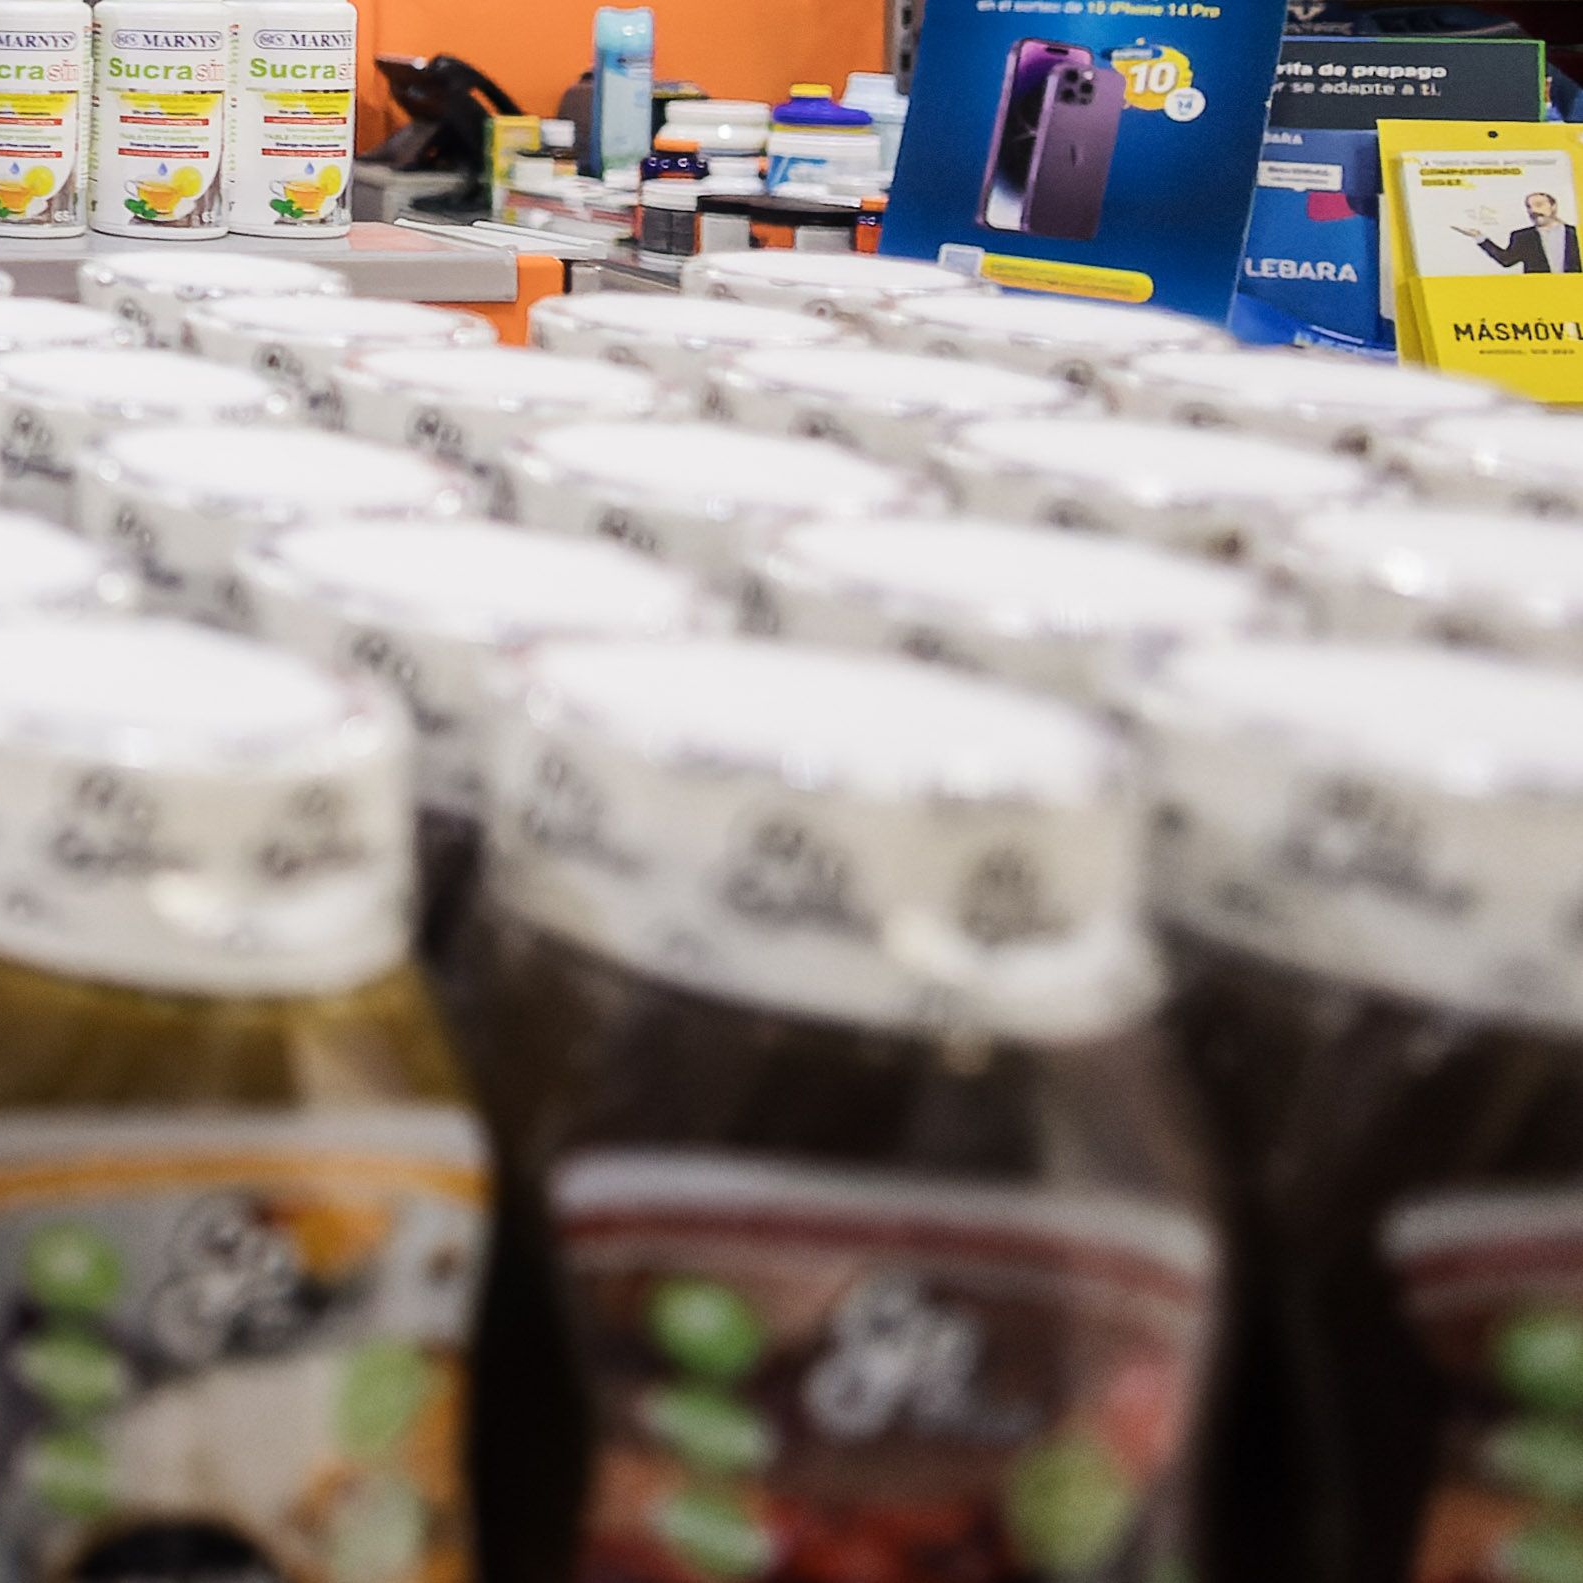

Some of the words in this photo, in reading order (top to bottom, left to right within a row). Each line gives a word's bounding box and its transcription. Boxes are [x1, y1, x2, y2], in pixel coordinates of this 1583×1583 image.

[143, 32, 217, 49] MARNYS
[1129, 61, 1178, 94] 10
[1318, 63, 1347, 77] de
[1351, 65, 1447, 81] prepago
[1293, 83, 1314, 95] se
[1319, 80, 1395, 97] adapte
[1401, 85, 1415, 96] a
[1244, 258, 1358, 283] LEBARA
